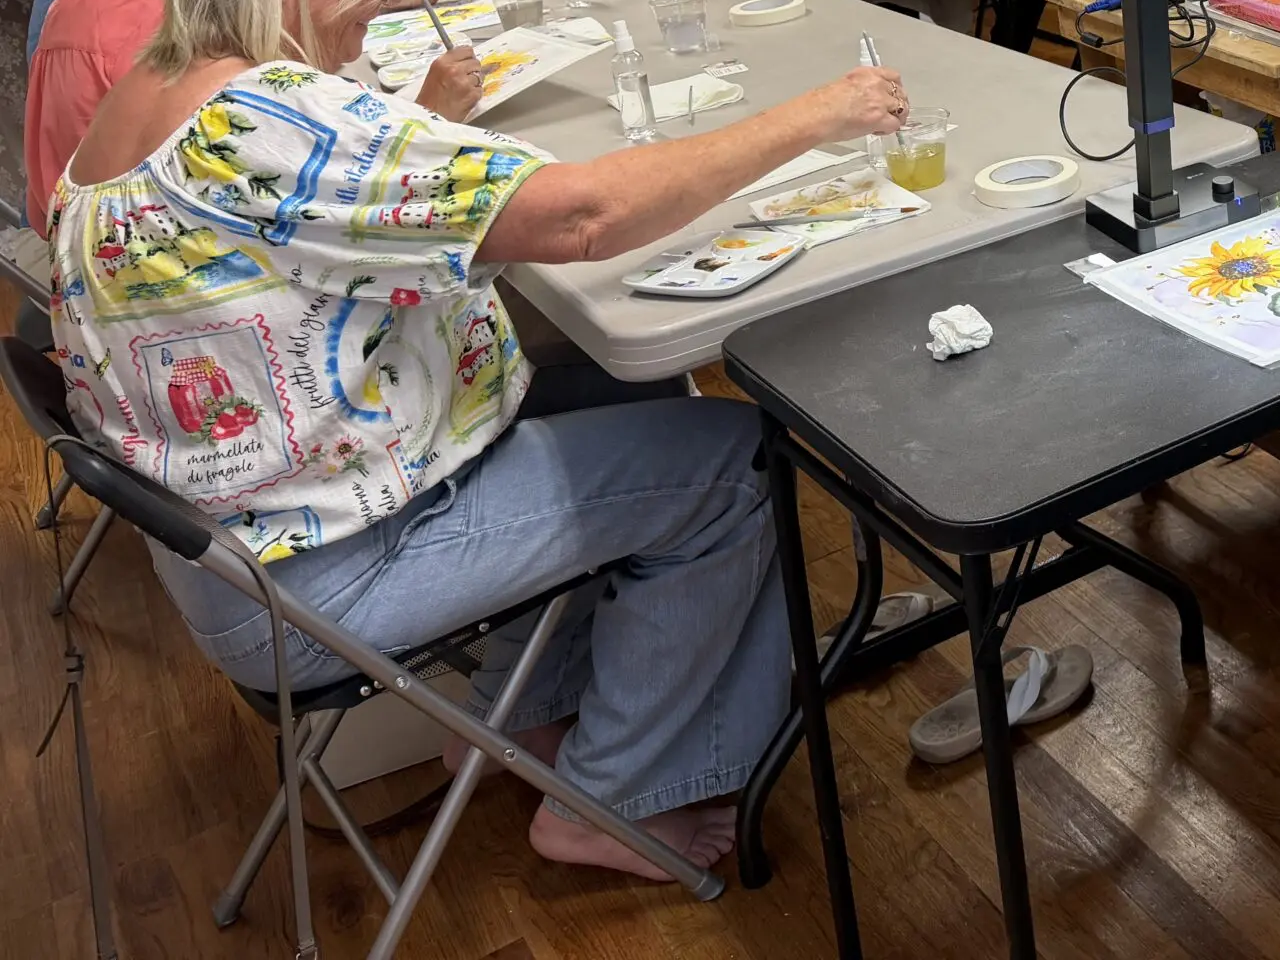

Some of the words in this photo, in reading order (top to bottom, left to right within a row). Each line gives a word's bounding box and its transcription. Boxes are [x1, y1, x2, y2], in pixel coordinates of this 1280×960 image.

[344, 123, 391, 186] italiana
[287, 331, 310, 359] del
[187, 439, 265, 466] marmellata
[187, 469, 203, 484] di
[206, 459, 254, 485] fragole
